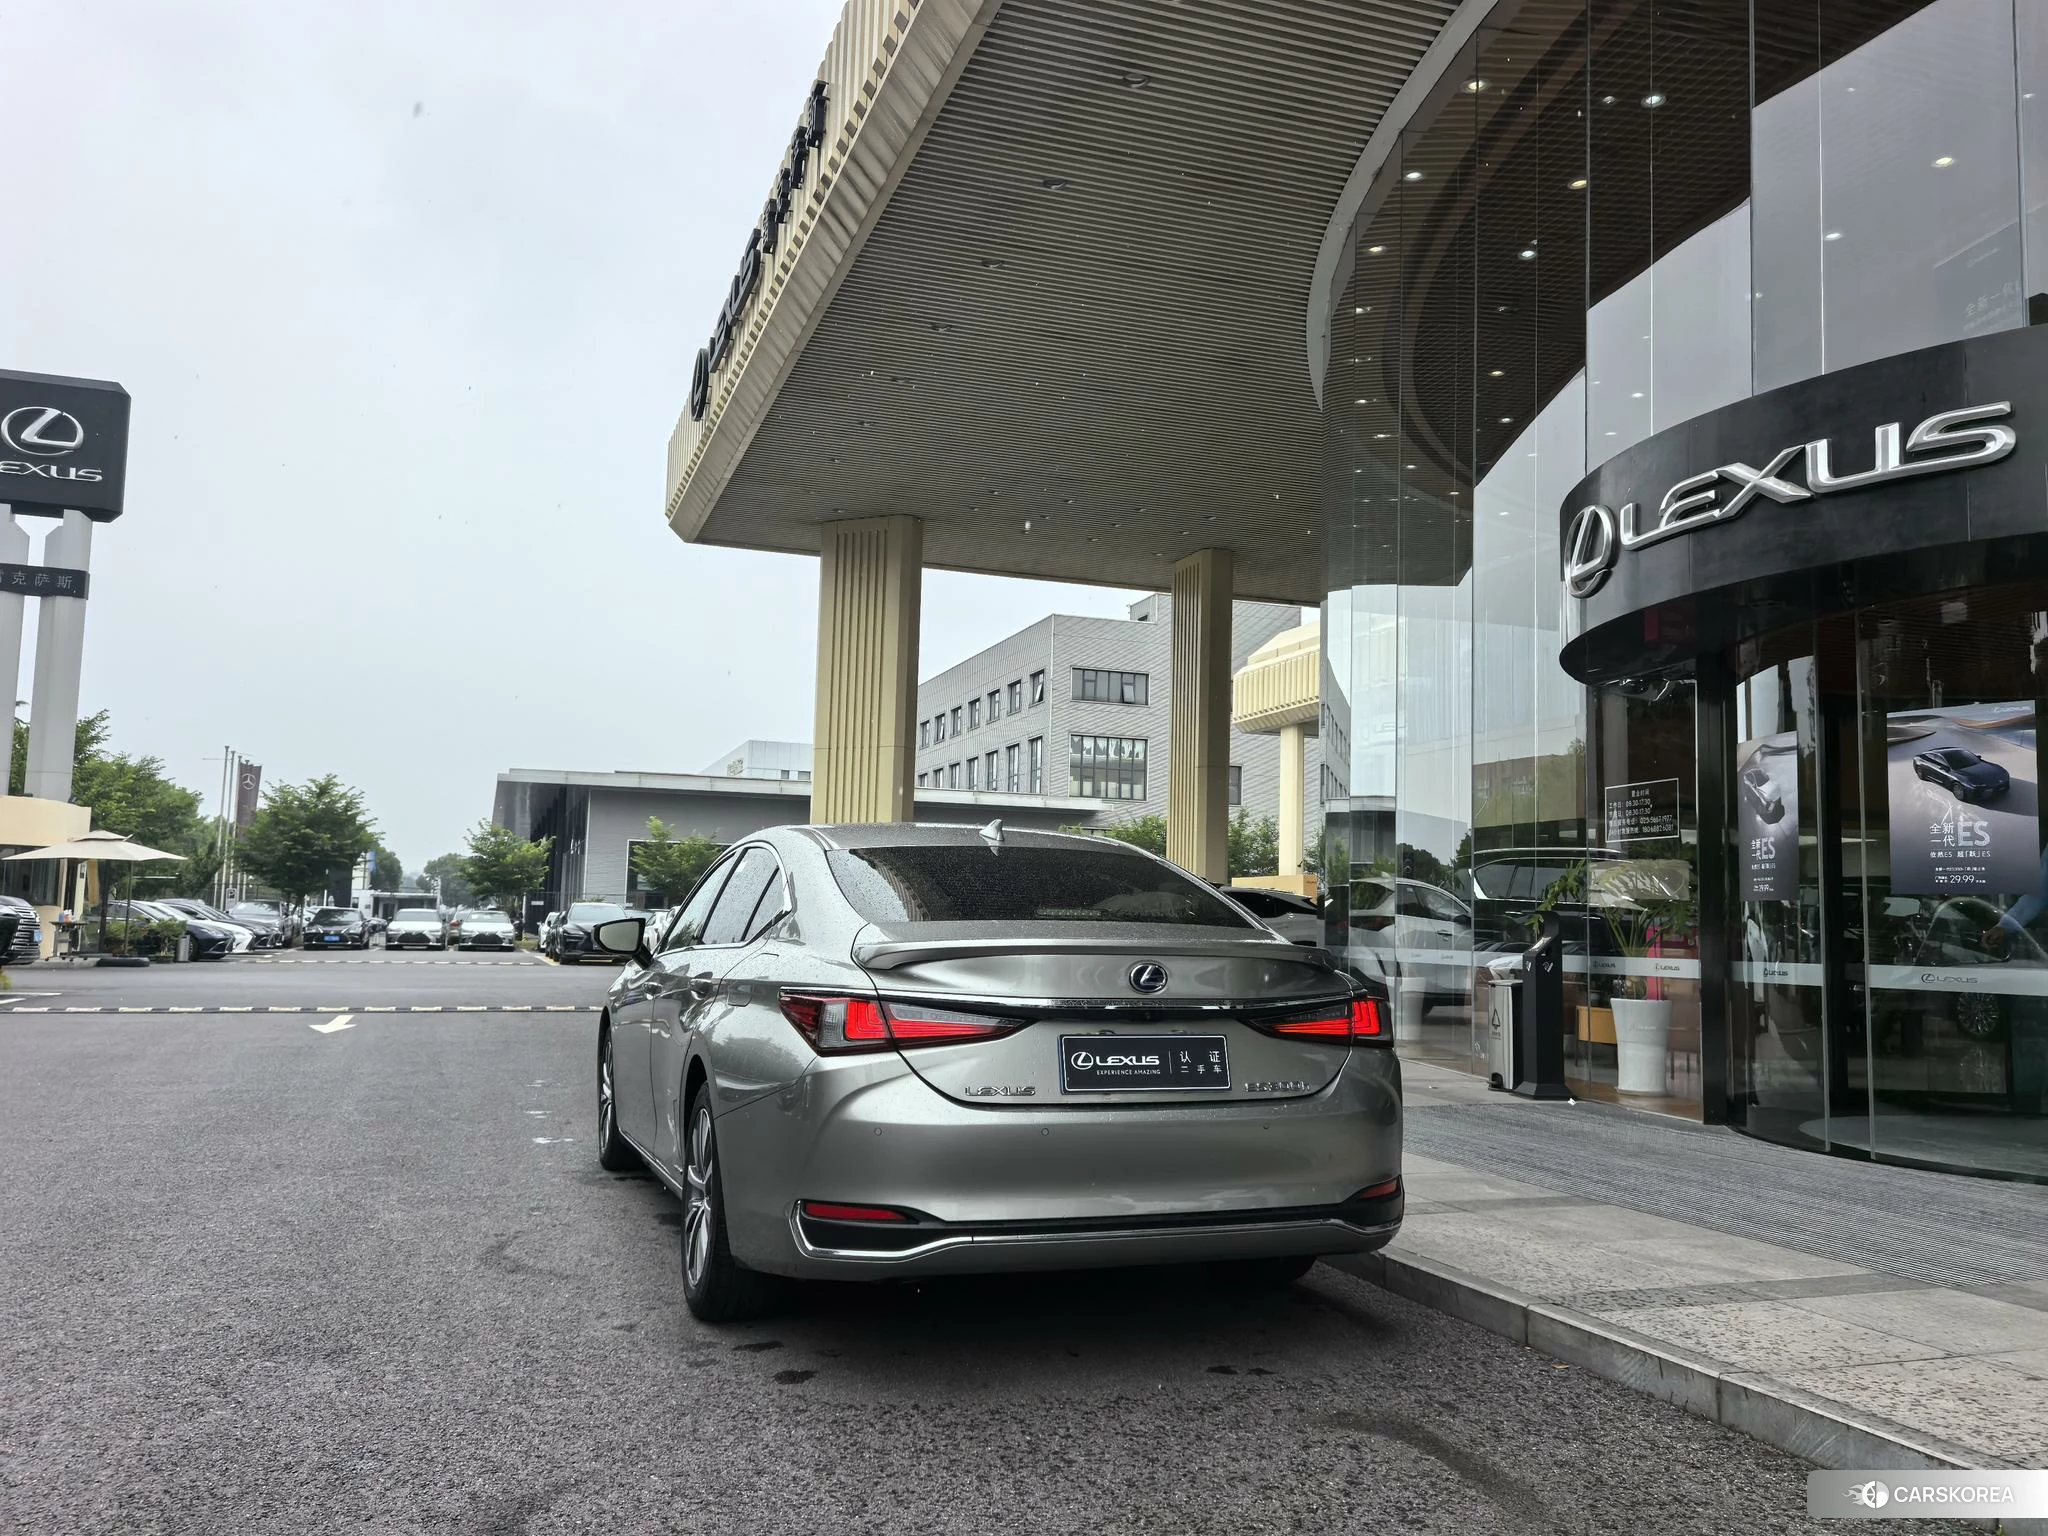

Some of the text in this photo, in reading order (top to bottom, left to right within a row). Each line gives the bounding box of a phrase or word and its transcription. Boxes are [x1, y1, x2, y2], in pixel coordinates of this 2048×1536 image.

[0, 461, 103, 482] EXUS
[1619, 400, 2017, 552] LEXUS
[0, 569, 73, 589] 克萨斯
[1957, 820, 1991, 847] ES
[1761, 837, 1776, 860] ES
[1936, 976, 1979, 985] LEXUS
[1095, 1055, 1160, 1066] LEXUS
[965, 1086, 1036, 1097] LEXUS
